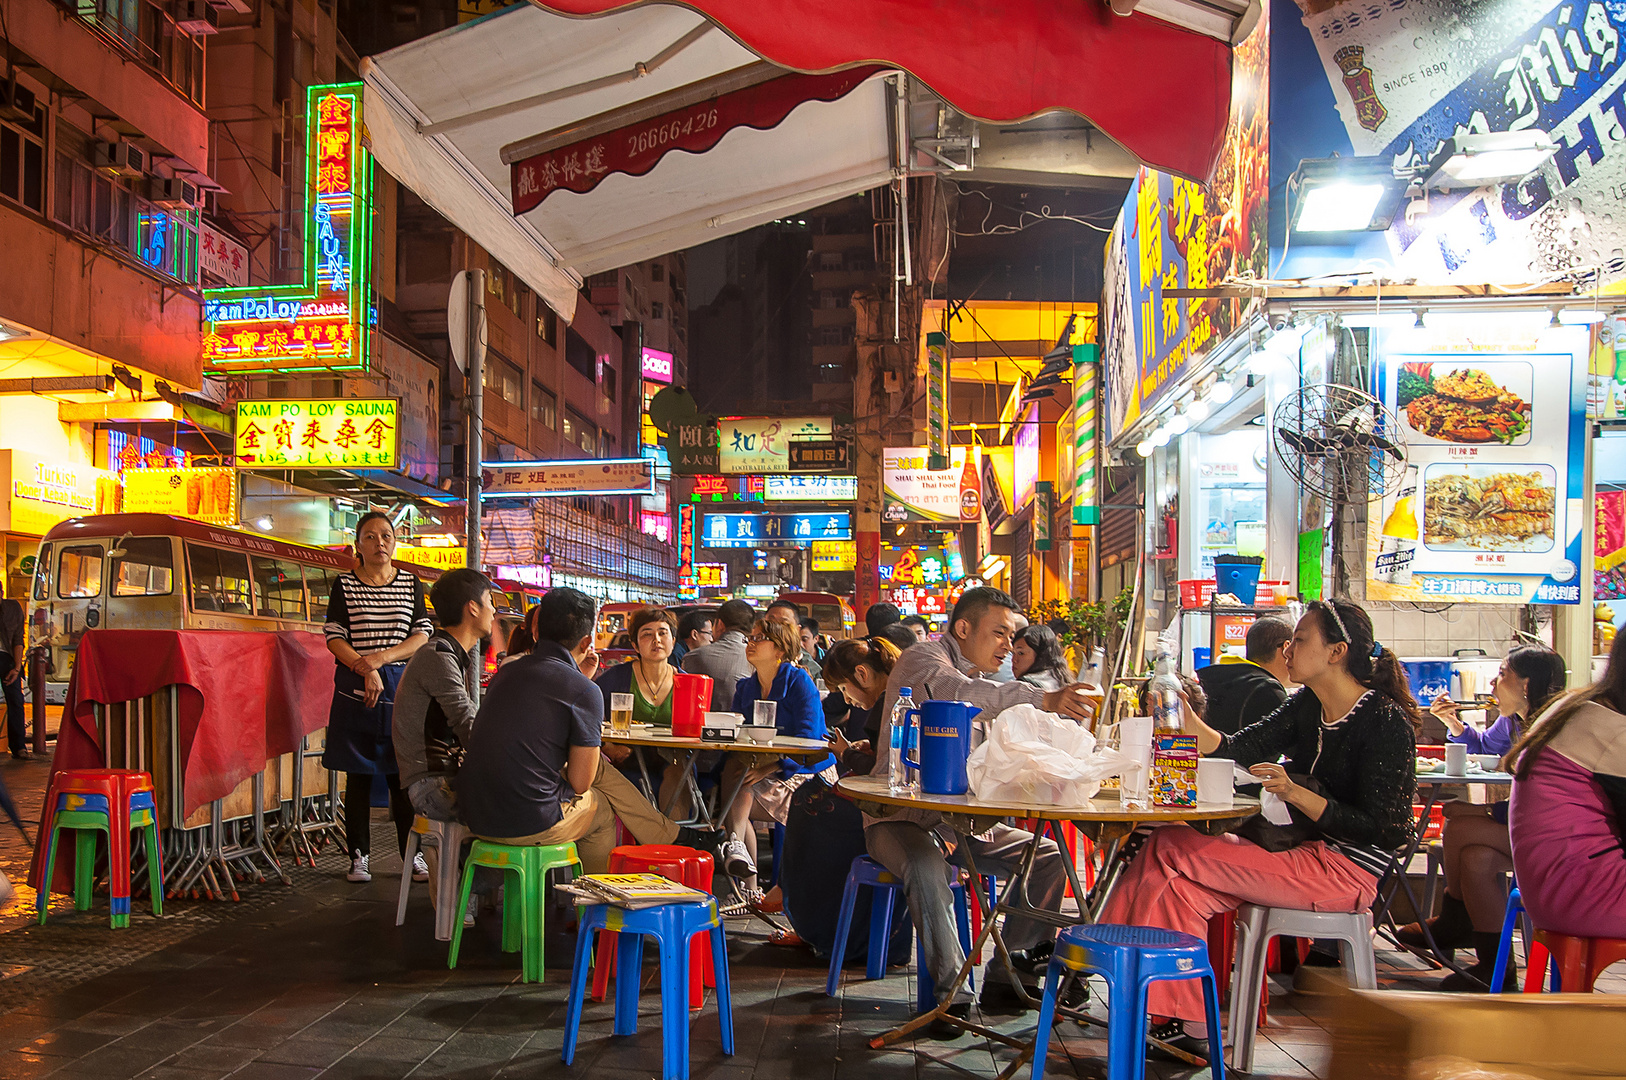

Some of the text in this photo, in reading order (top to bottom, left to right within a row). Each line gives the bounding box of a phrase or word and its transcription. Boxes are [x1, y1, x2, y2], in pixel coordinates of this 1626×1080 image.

[1383, 62, 1448, 93] SINCE 1890
[628, 108, 718, 158] 26666426
[314, 203, 347, 292] SAUNA
[1189, 315, 1211, 354] CRAB
[239, 403, 395, 416] KAM PO LOY SAUNA
[37, 462, 77, 487] Turkish
[503, 471, 547, 485] 肥姐
[17, 480, 94, 507] Doner Kebab House
[1379, 562, 1411, 575] LIGHT
